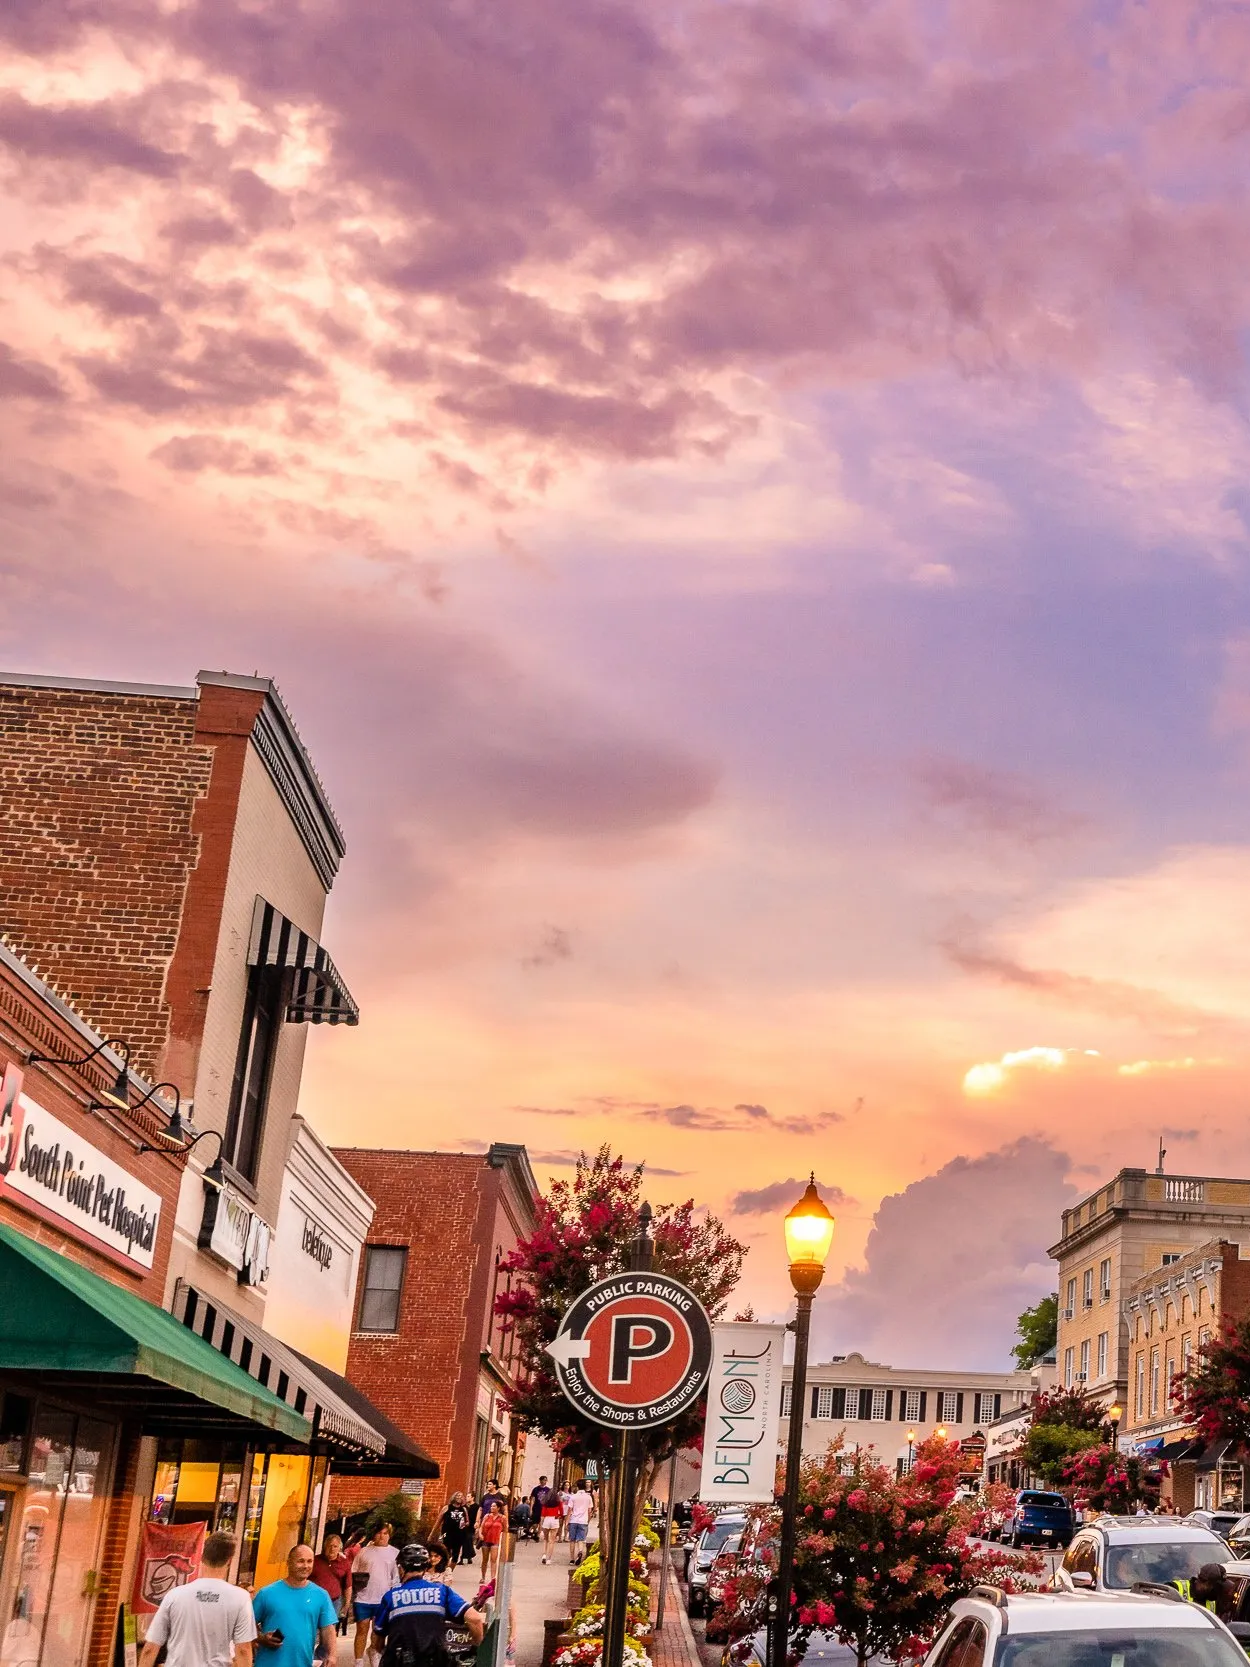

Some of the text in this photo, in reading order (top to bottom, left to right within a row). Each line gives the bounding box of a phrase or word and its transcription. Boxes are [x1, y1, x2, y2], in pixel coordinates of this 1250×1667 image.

[20, 1123, 60, 1192] South
[59, 1150, 94, 1214] Point
[92, 1173, 114, 1226] Pet
[111, 1187, 157, 1254] Hospital
[586, 1281, 693, 1312] PUBLIC PARKING
[608, 1313, 675, 1385] P
[565, 1367, 702, 1423] Enjoy the Shops & Restaurants
[713, 1341, 772, 1485] BELMONT
[761, 1352, 772, 1430] NORTH CAROLINA
[391, 1587, 441, 1607] POLICE
